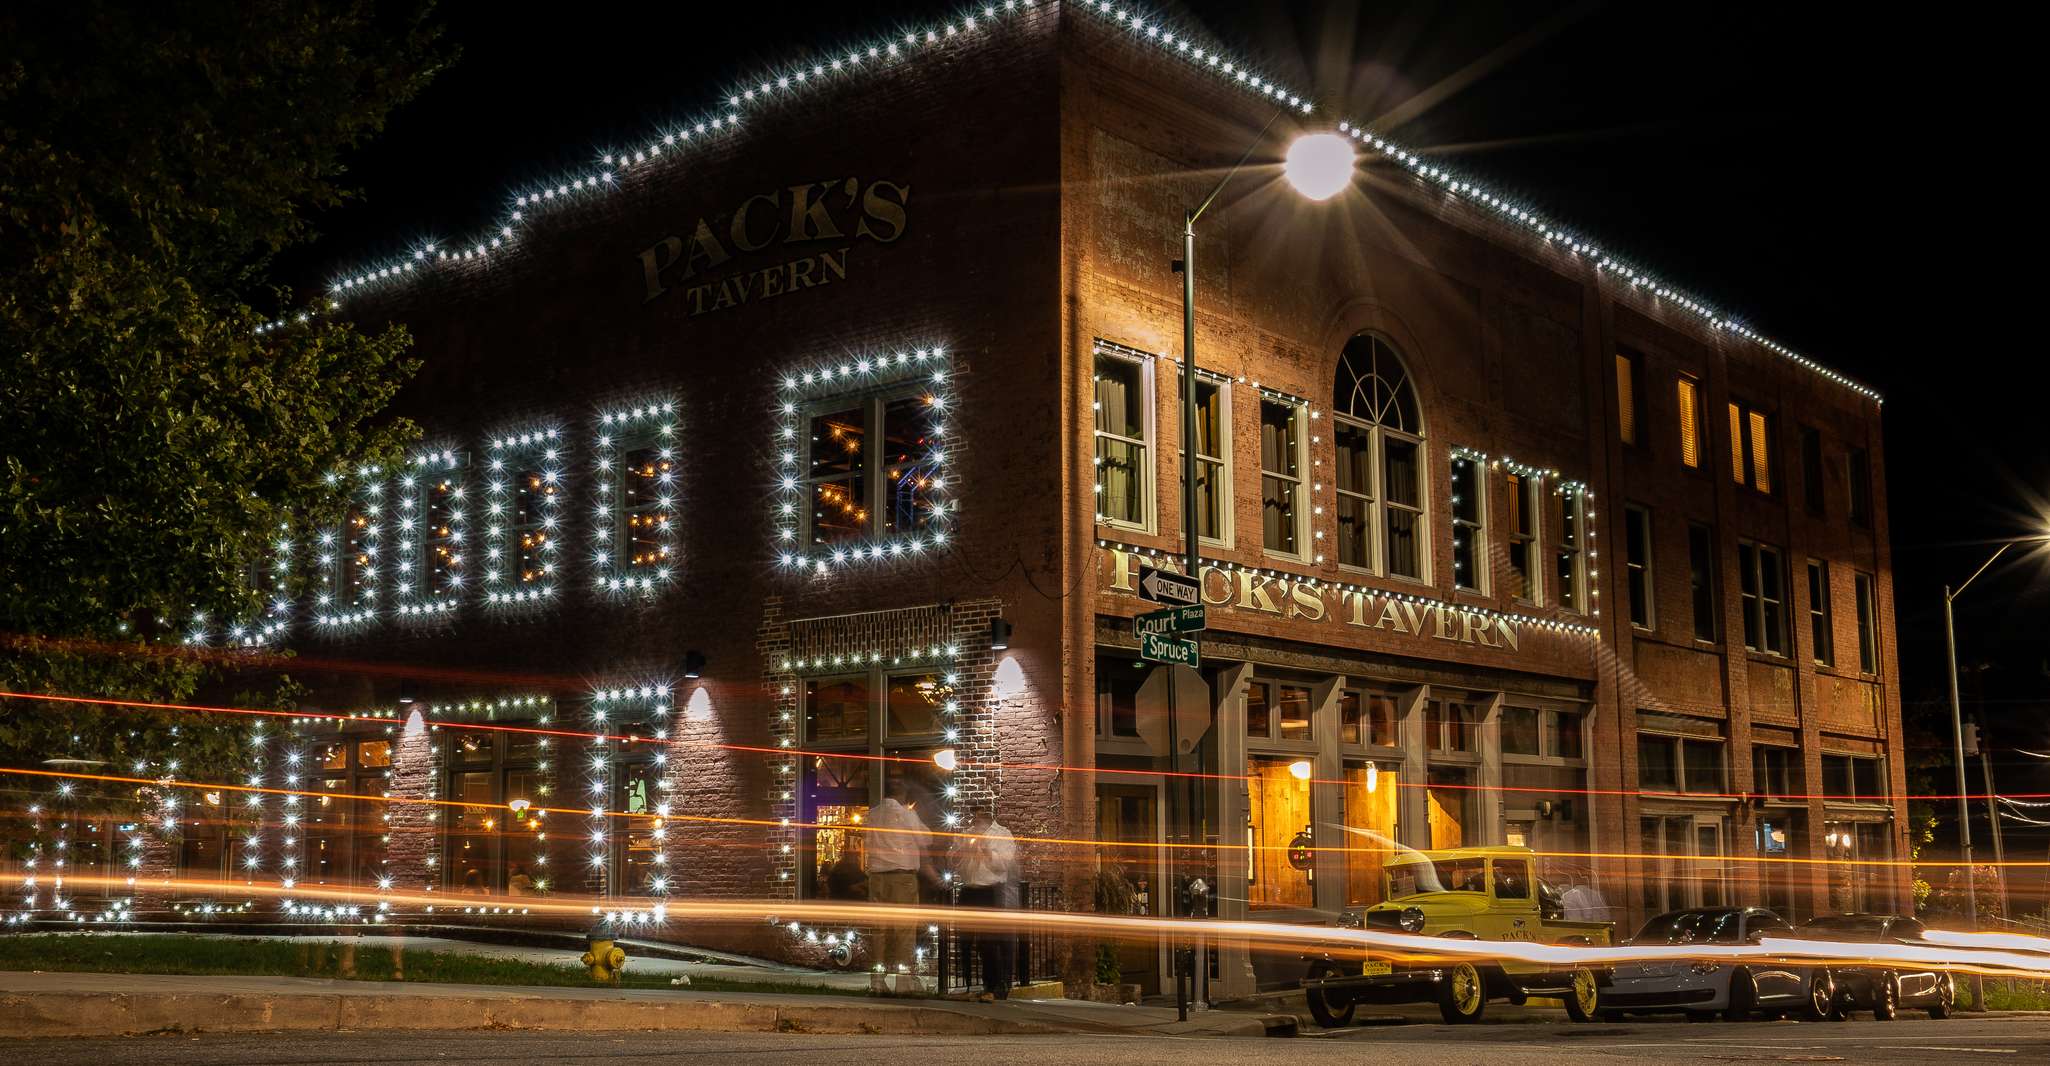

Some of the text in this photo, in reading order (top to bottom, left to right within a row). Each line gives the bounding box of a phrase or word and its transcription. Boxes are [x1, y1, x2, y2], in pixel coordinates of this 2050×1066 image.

[635, 176, 911, 304] PACK'S
[687, 247, 850, 317] TAVERN
[1156, 580, 1194, 600] ONE WAY
[1136, 608, 1204, 636] Court Plaza
[1342, 589, 1523, 651] TAVERN
[1142, 633, 1148, 644] S
[1150, 635, 1188, 661] Spruce
